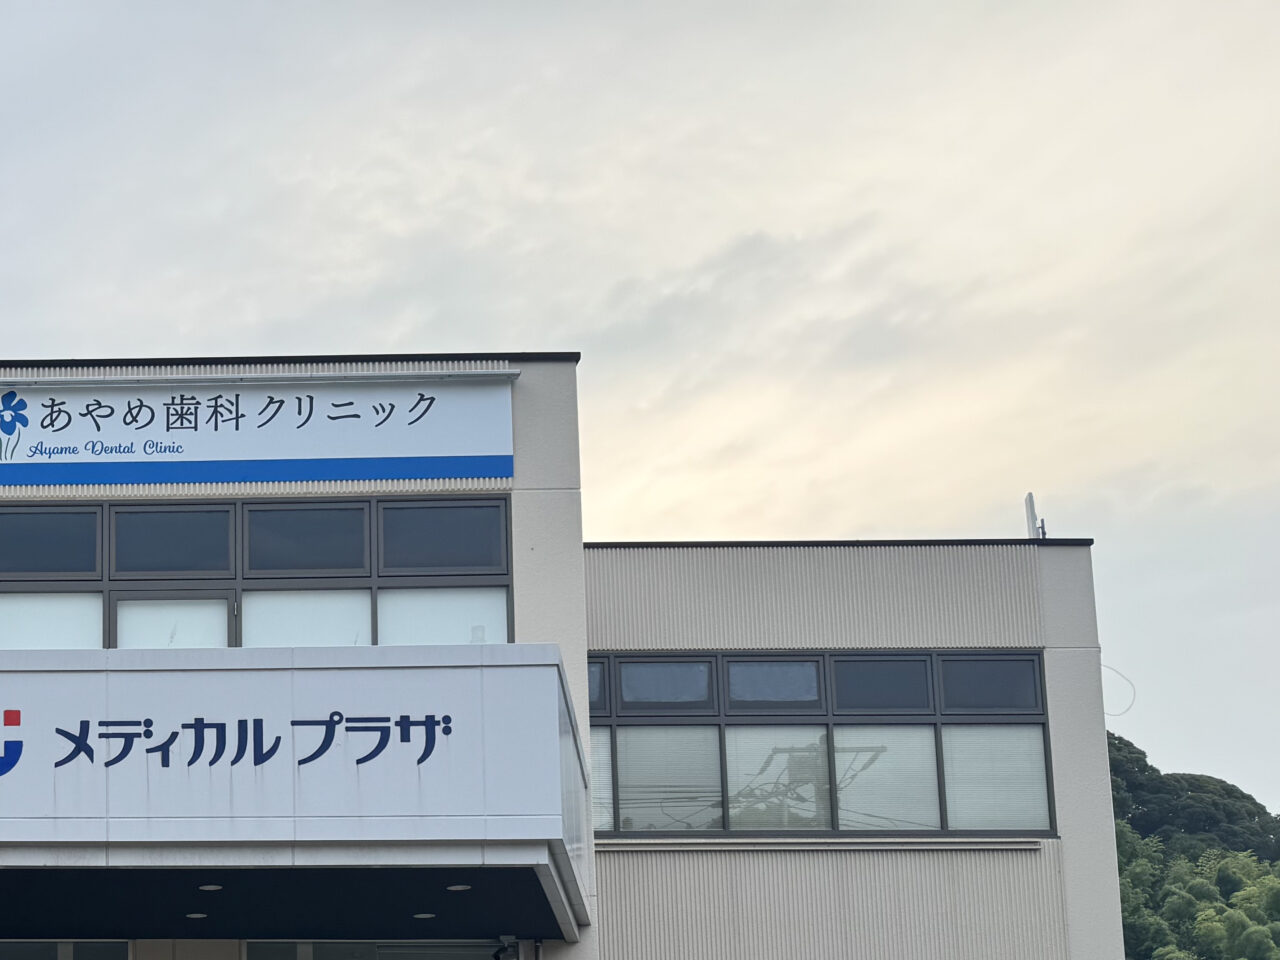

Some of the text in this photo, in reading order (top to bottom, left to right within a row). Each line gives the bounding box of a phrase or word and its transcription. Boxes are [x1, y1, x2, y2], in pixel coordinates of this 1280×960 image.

[40, 392, 436, 433] あやめ歯科クリニック
[26, 440, 79, 459] Ayame
[84, 440, 136, 456] Dental
[143, 439, 184, 456] Clinic
